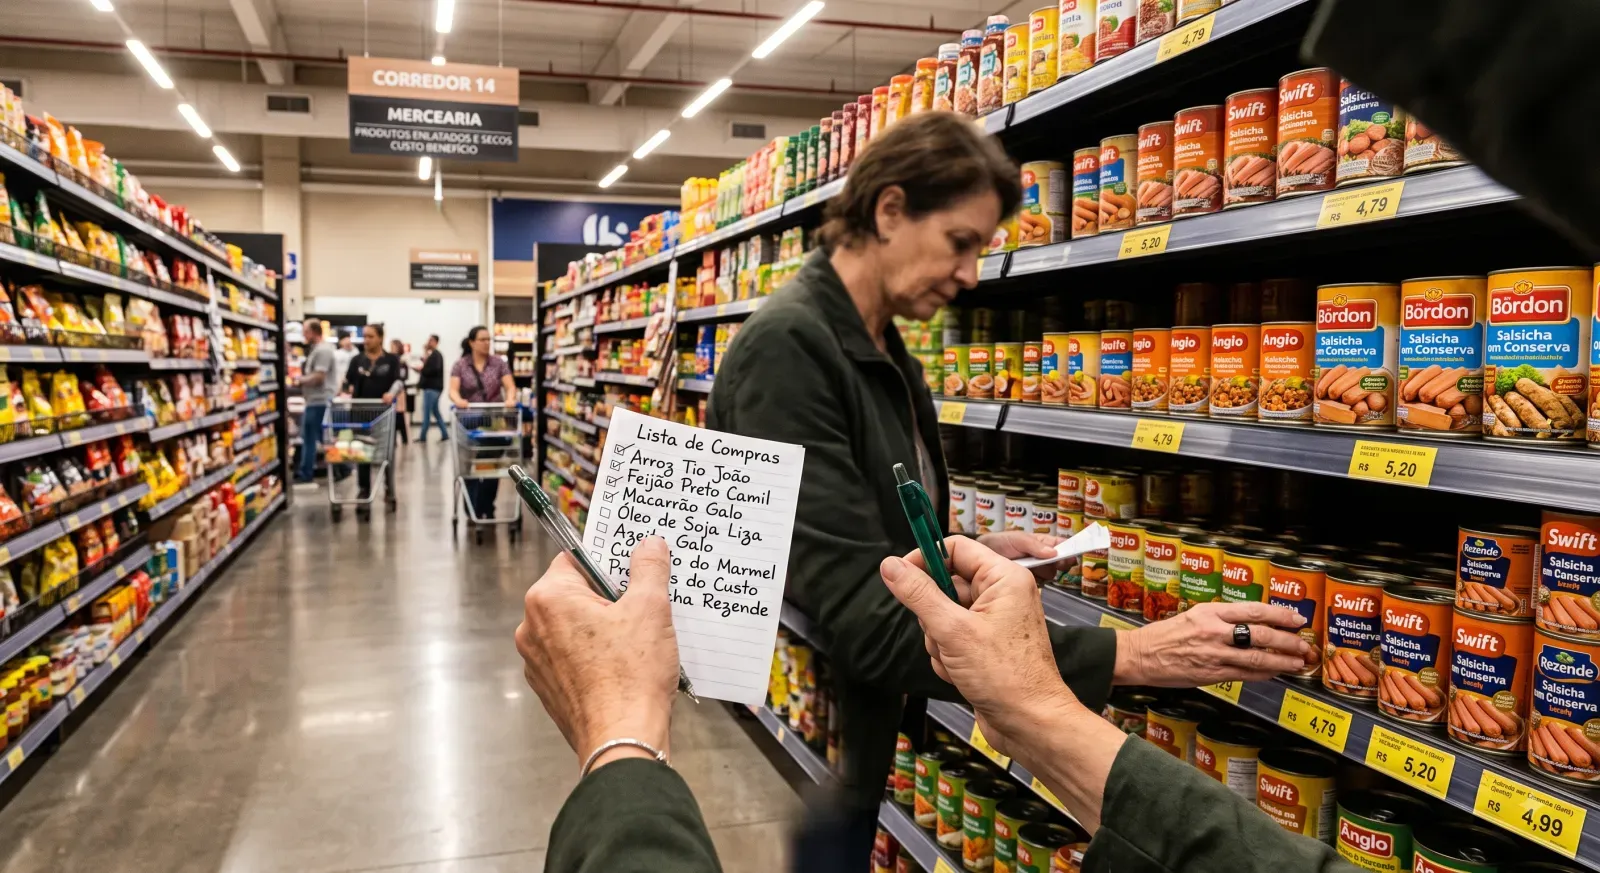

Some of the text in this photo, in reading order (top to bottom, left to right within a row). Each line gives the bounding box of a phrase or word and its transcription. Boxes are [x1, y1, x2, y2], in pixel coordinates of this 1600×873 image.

[1181, 27, 1205, 47] 4,79
[373, 70, 496, 93] CORREDOR 14
[1280, 83, 1315, 104] Swift
[387, 107, 482, 126] MERCEARIA
[1228, 101, 1266, 122] Swift
[354, 127, 513, 146] PRODUTOS ENLATADOS E SECOS
[390, 141, 424, 151] CUSTO
[1330, 212, 1342, 222] R$
[1355, 196, 1388, 217] 4,79
[1141, 236, 1161, 251] 5,20
[1321, 336, 1362, 346] Salsicha
[1409, 333, 1459, 344] Salsicha
[1496, 329, 1552, 341] Salsicha
[1325, 346, 1377, 356] Conserva
[1415, 344, 1474, 355] Conserva
[1503, 342, 1570, 353] Conserva
[637, 424, 780, 465] Lista de Compras
[1153, 433, 1173, 446] 4,79
[630, 449, 751, 484] Arroz Tio João
[1358, 460, 1417, 478] R$ 5,20
[627, 468, 771, 506] Feijão Preto Camil
[622, 487, 743, 520] Macarrão Galo
[617, 503, 763, 546] Óleo de Soja Liza
[676, 534, 714, 553] Galo
[1548, 528, 1598, 551] Swift
[1464, 544, 1499, 557] Rezende
[689, 555, 709, 570] do
[717, 558, 776, 580] Marmel
[1222, 564, 1248, 582] Swift
[1467, 560, 1493, 571] Salsicha
[1549, 556, 1594, 572] Salsicha
[686, 573, 706, 588] do
[713, 577, 758, 596] Custo
[1270, 577, 1301, 596] Swift
[703, 593, 769, 617] Rezende
[1334, 594, 1375, 613] Swift
[1335, 617, 1372, 631] Salsicha
[1385, 609, 1423, 631] Swift
[1385, 634, 1421, 651] Salsicha
[1456, 628, 1498, 652] Swift
[1456, 655, 1495, 673] Salsicha
[1540, 656, 1594, 678] Rezende
[1542, 680, 1585, 699] Salsicha
[1546, 693, 1598, 712] Conserva
[1287, 711, 1336, 737] R$ 4,79
[1376, 750, 1436, 782] R$ 5,20
[1260, 778, 1293, 801] Swift
[1487, 799, 1563, 837] R$ 4,99
